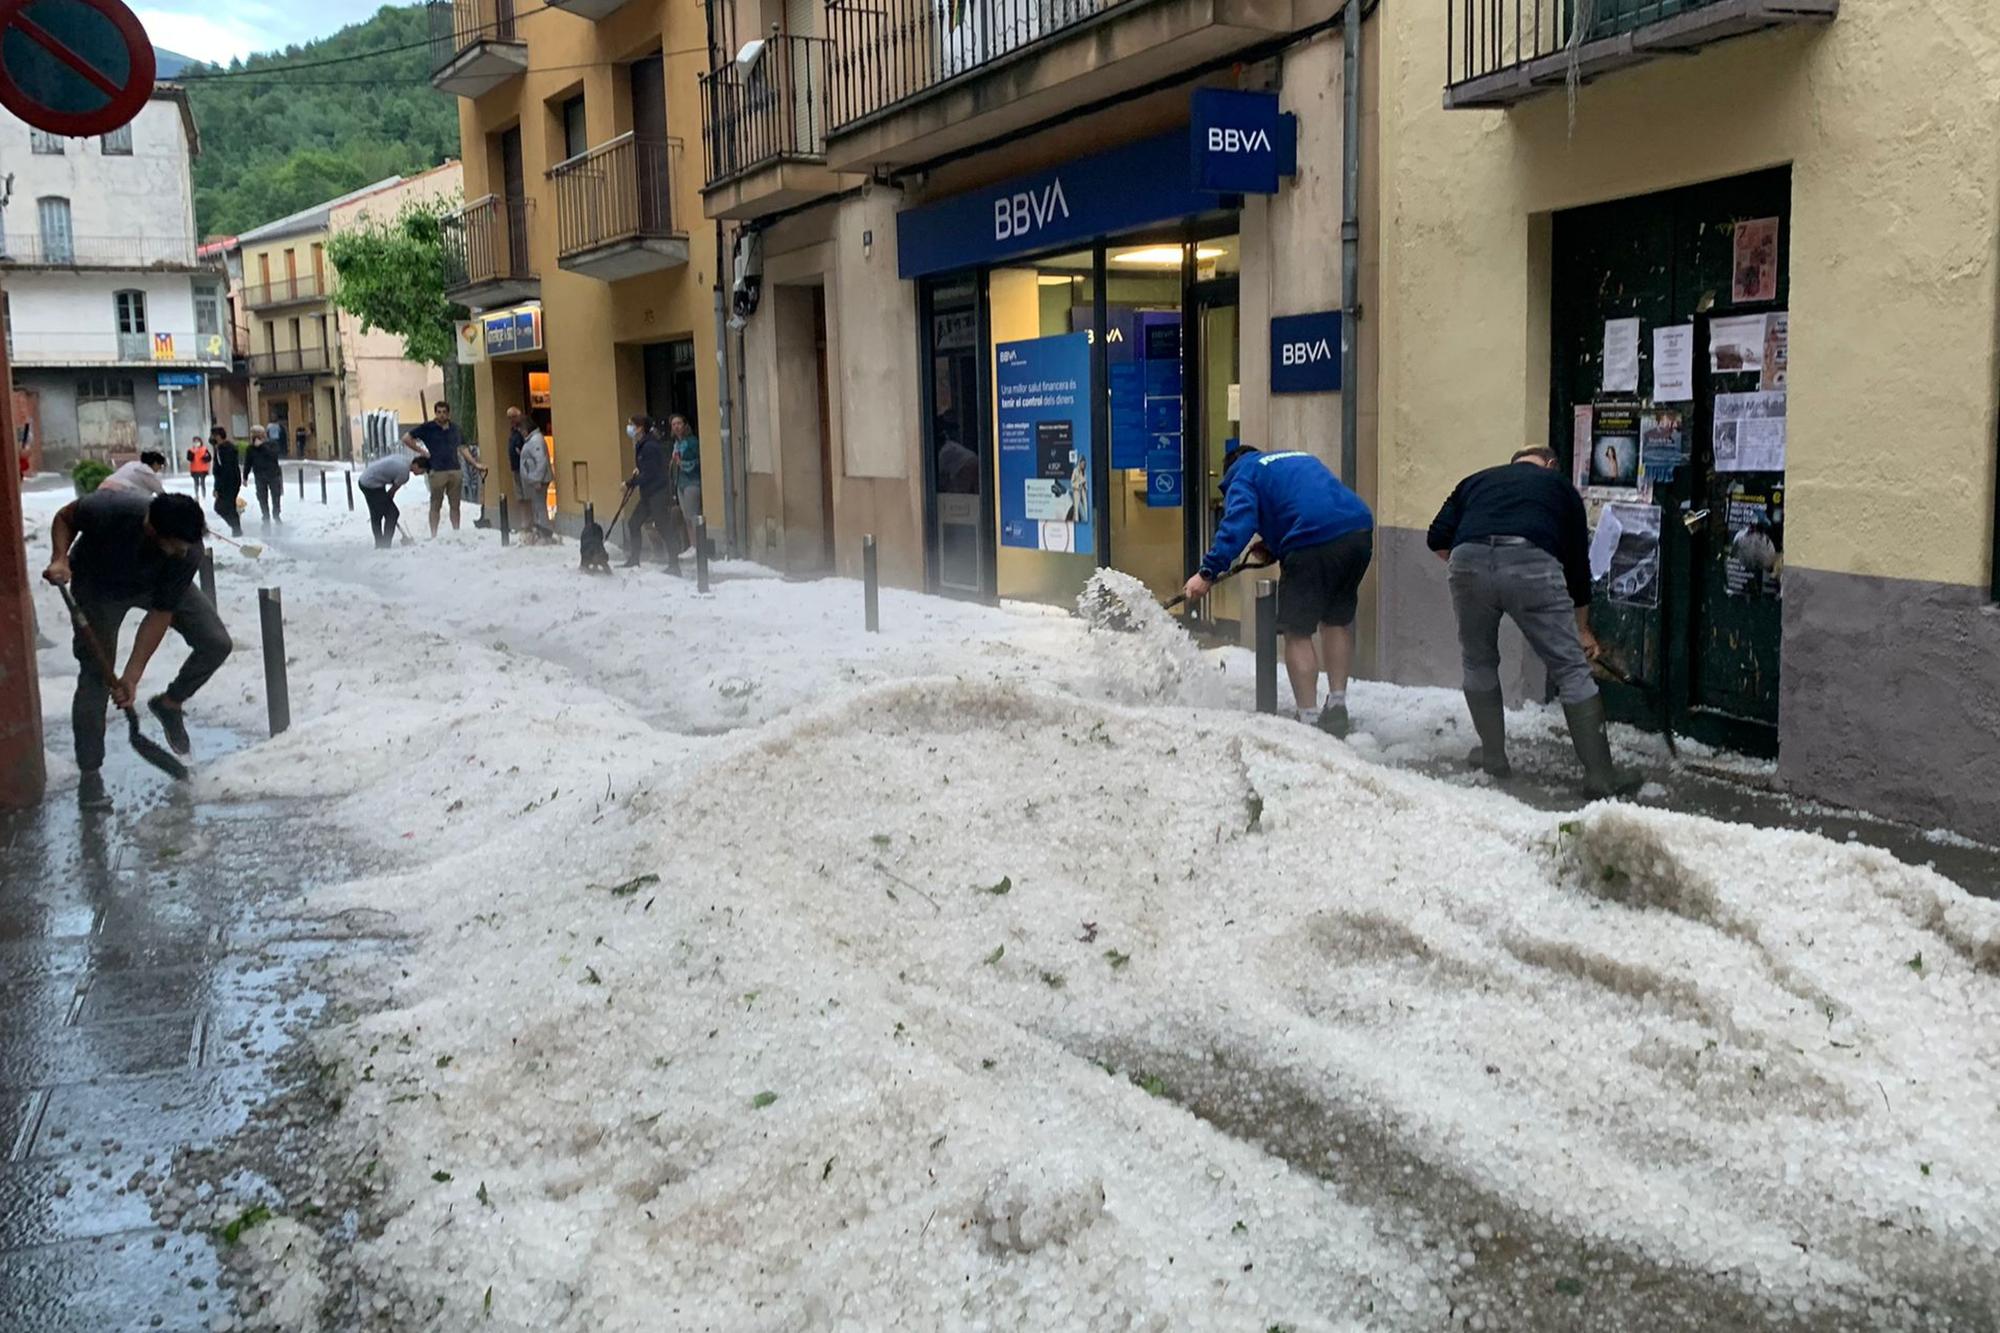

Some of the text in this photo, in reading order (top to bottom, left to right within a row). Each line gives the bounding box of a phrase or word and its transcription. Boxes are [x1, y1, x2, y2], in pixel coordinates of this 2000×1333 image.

[1208, 127, 1271, 154] BBVA
[994, 178, 1069, 240] BBVA
[1000, 349, 1017, 363] BBVA
[1282, 337, 1331, 365] BBVA
[1001, 384, 1012, 395] Una
[1013, 382, 1027, 394] millor
[1029, 381, 1042, 393] salut
[1042, 380, 1069, 392] financera
[1001, 398, 1015, 409] tenir
[1015, 397, 1021, 408] el
[1022, 396, 1043, 407] control
[1056, 394, 1074, 406] diners
